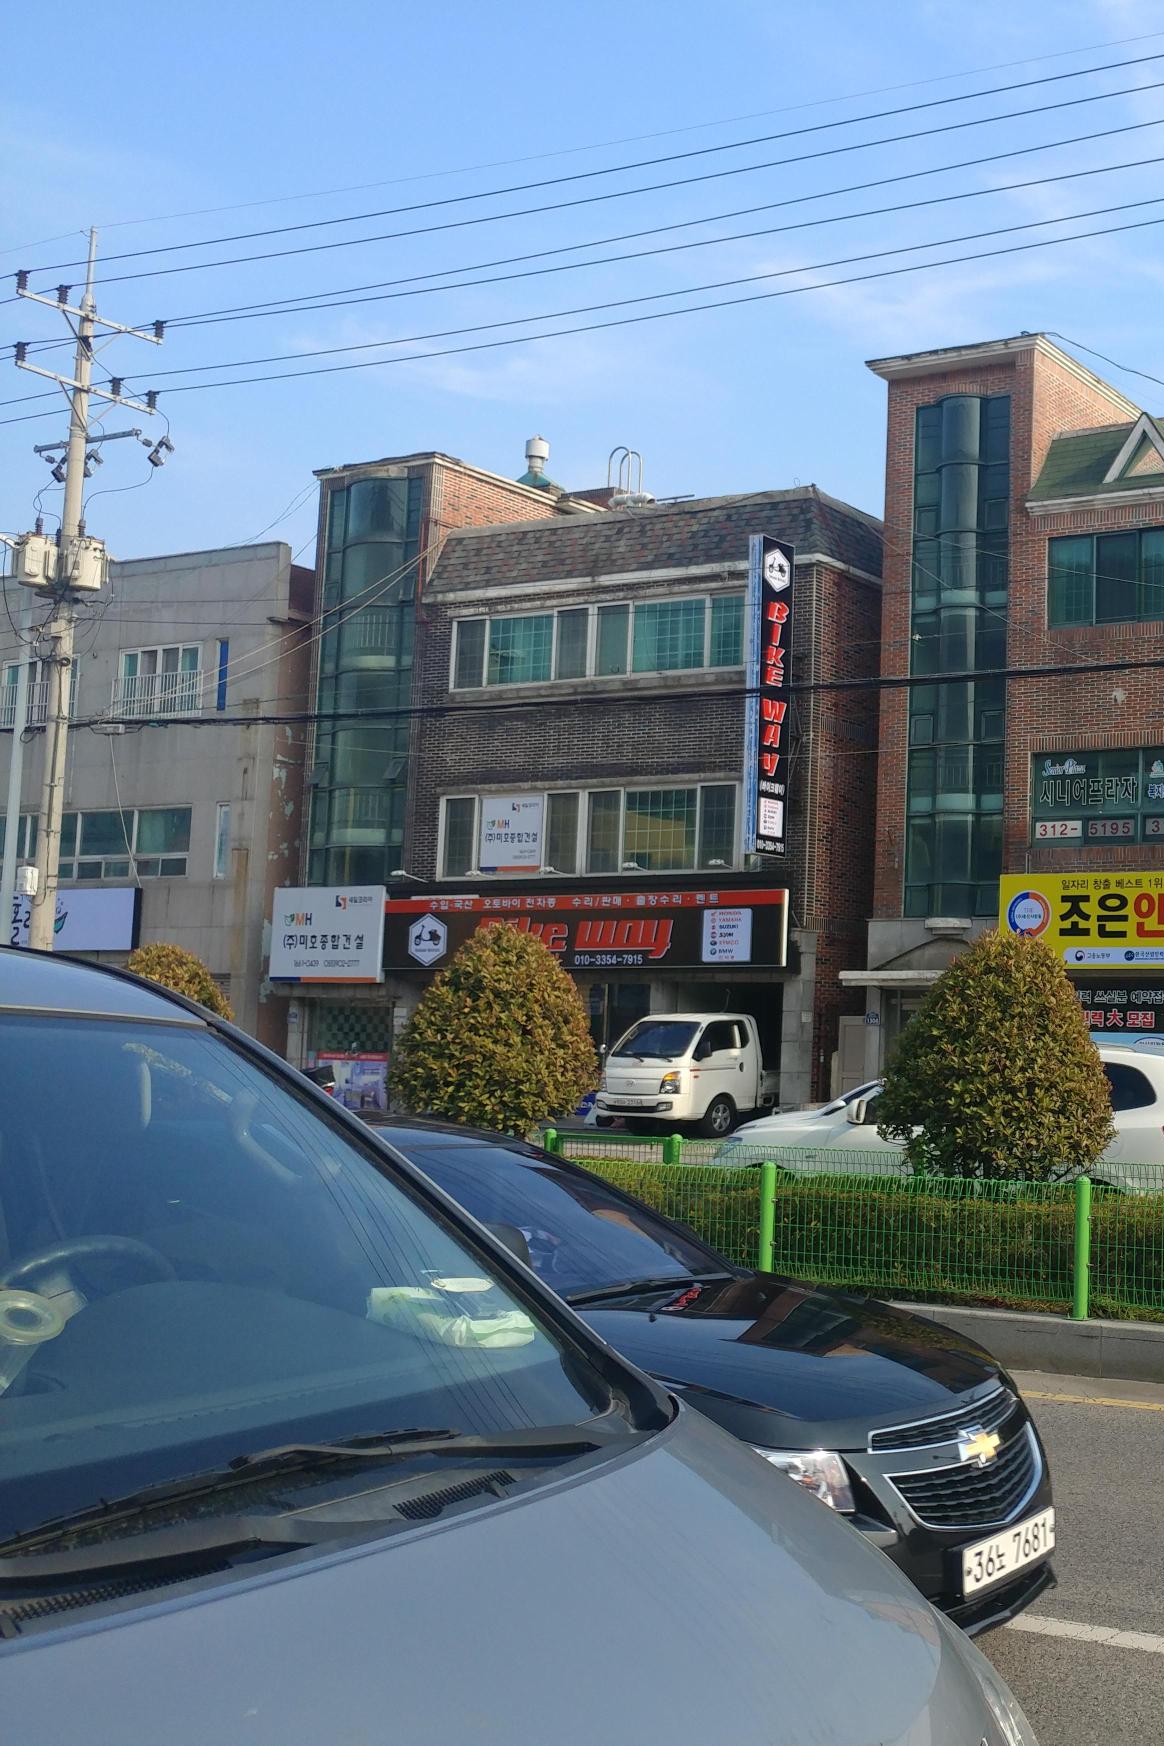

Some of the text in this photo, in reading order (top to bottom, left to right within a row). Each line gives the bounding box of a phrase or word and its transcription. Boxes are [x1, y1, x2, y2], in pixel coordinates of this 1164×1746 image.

[766, 601, 790, 687] BIKE
[763, 698, 787, 777] WAY
[1039, 776, 1138, 807] 시니어프라자
[1038, 822, 1079, 837] 312-
[1089, 821, 1131, 836] 5195
[1061, 879, 1089, 890] 일자리
[1093, 878, 1111, 890] 창출
[1115, 878, 1143, 889] 베스트
[482, 898, 521, 909] 오토바이
[283, 934, 364, 951] (주)미호종합건설
[574, 954, 643, 965] 010-3354-7915
[1077, 990, 1092, 1005] 력
[1094, 990, 1128, 1004] 쓰실분
[1127, 1011, 1155, 1028] 모집
[974, 1517, 1047, 1583] 36노 7681
